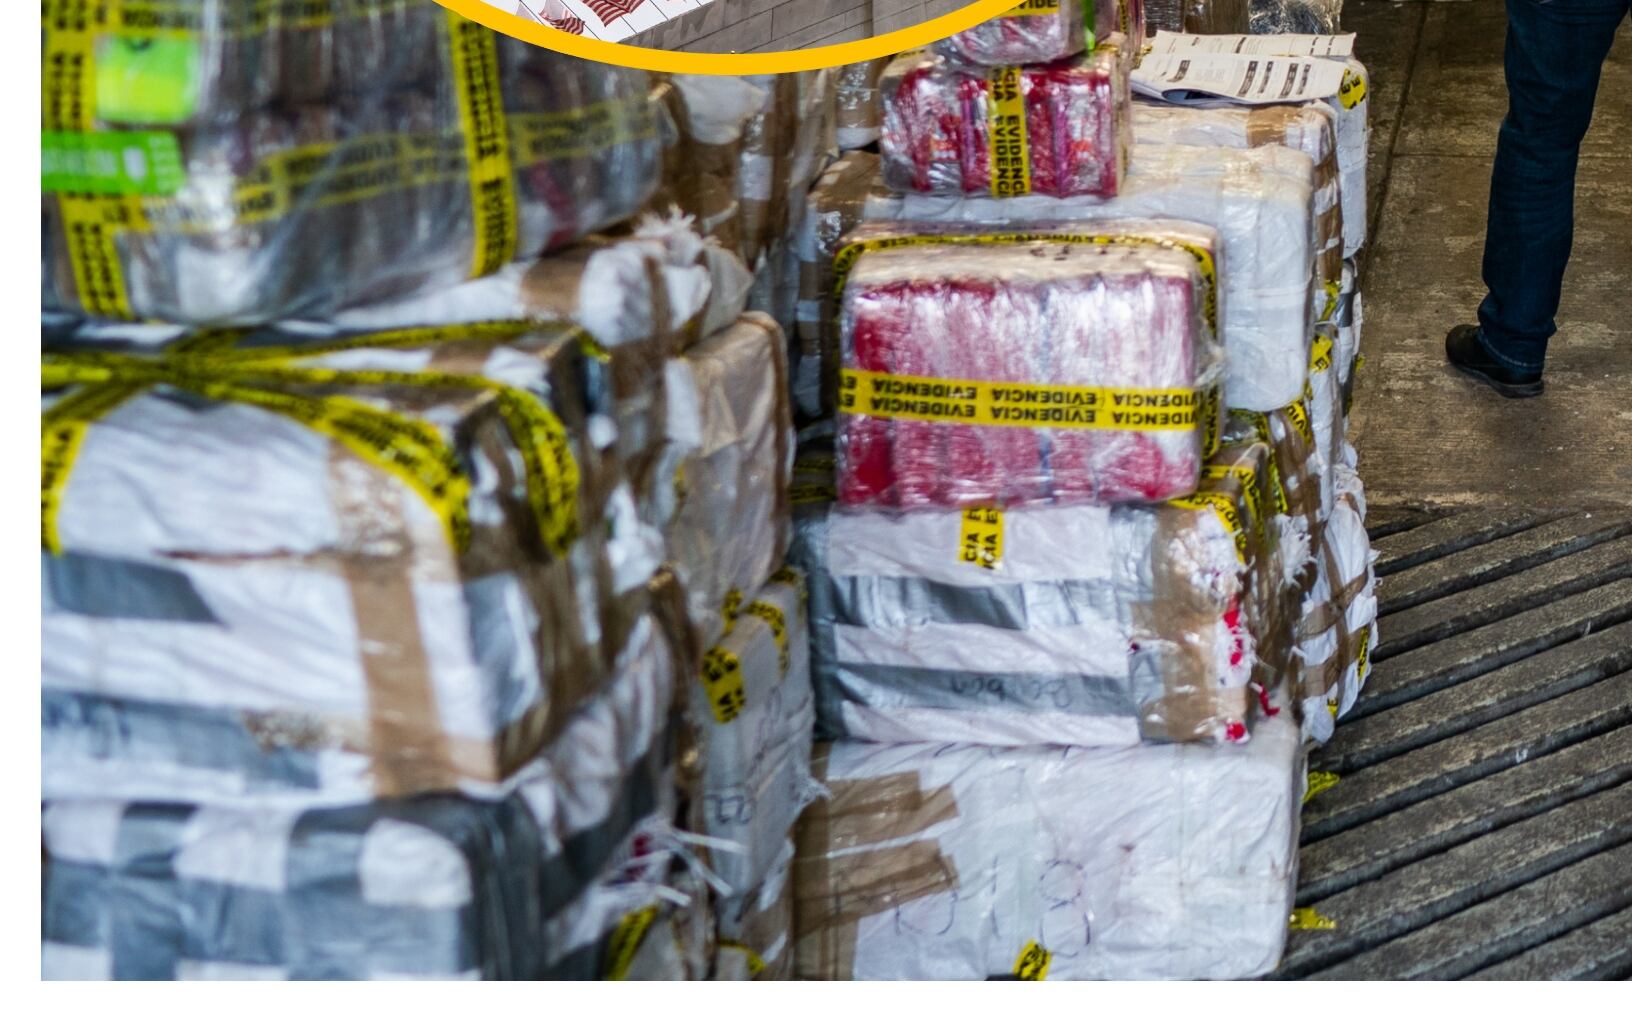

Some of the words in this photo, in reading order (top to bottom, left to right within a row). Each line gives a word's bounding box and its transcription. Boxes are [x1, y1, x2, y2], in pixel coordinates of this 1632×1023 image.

[1007, 115, 1027, 196] EVIDENC
[870, 378, 978, 401] EVIDENCIA
[991, 387, 1098, 406] EVIDENCIA
[870, 396, 976, 419] EVIDENCIA
[1112, 391, 1197, 408] VIDENCIA
[991, 406, 1097, 423] EVIDENCIA
[1112, 409, 1198, 425] VIDENCIA
